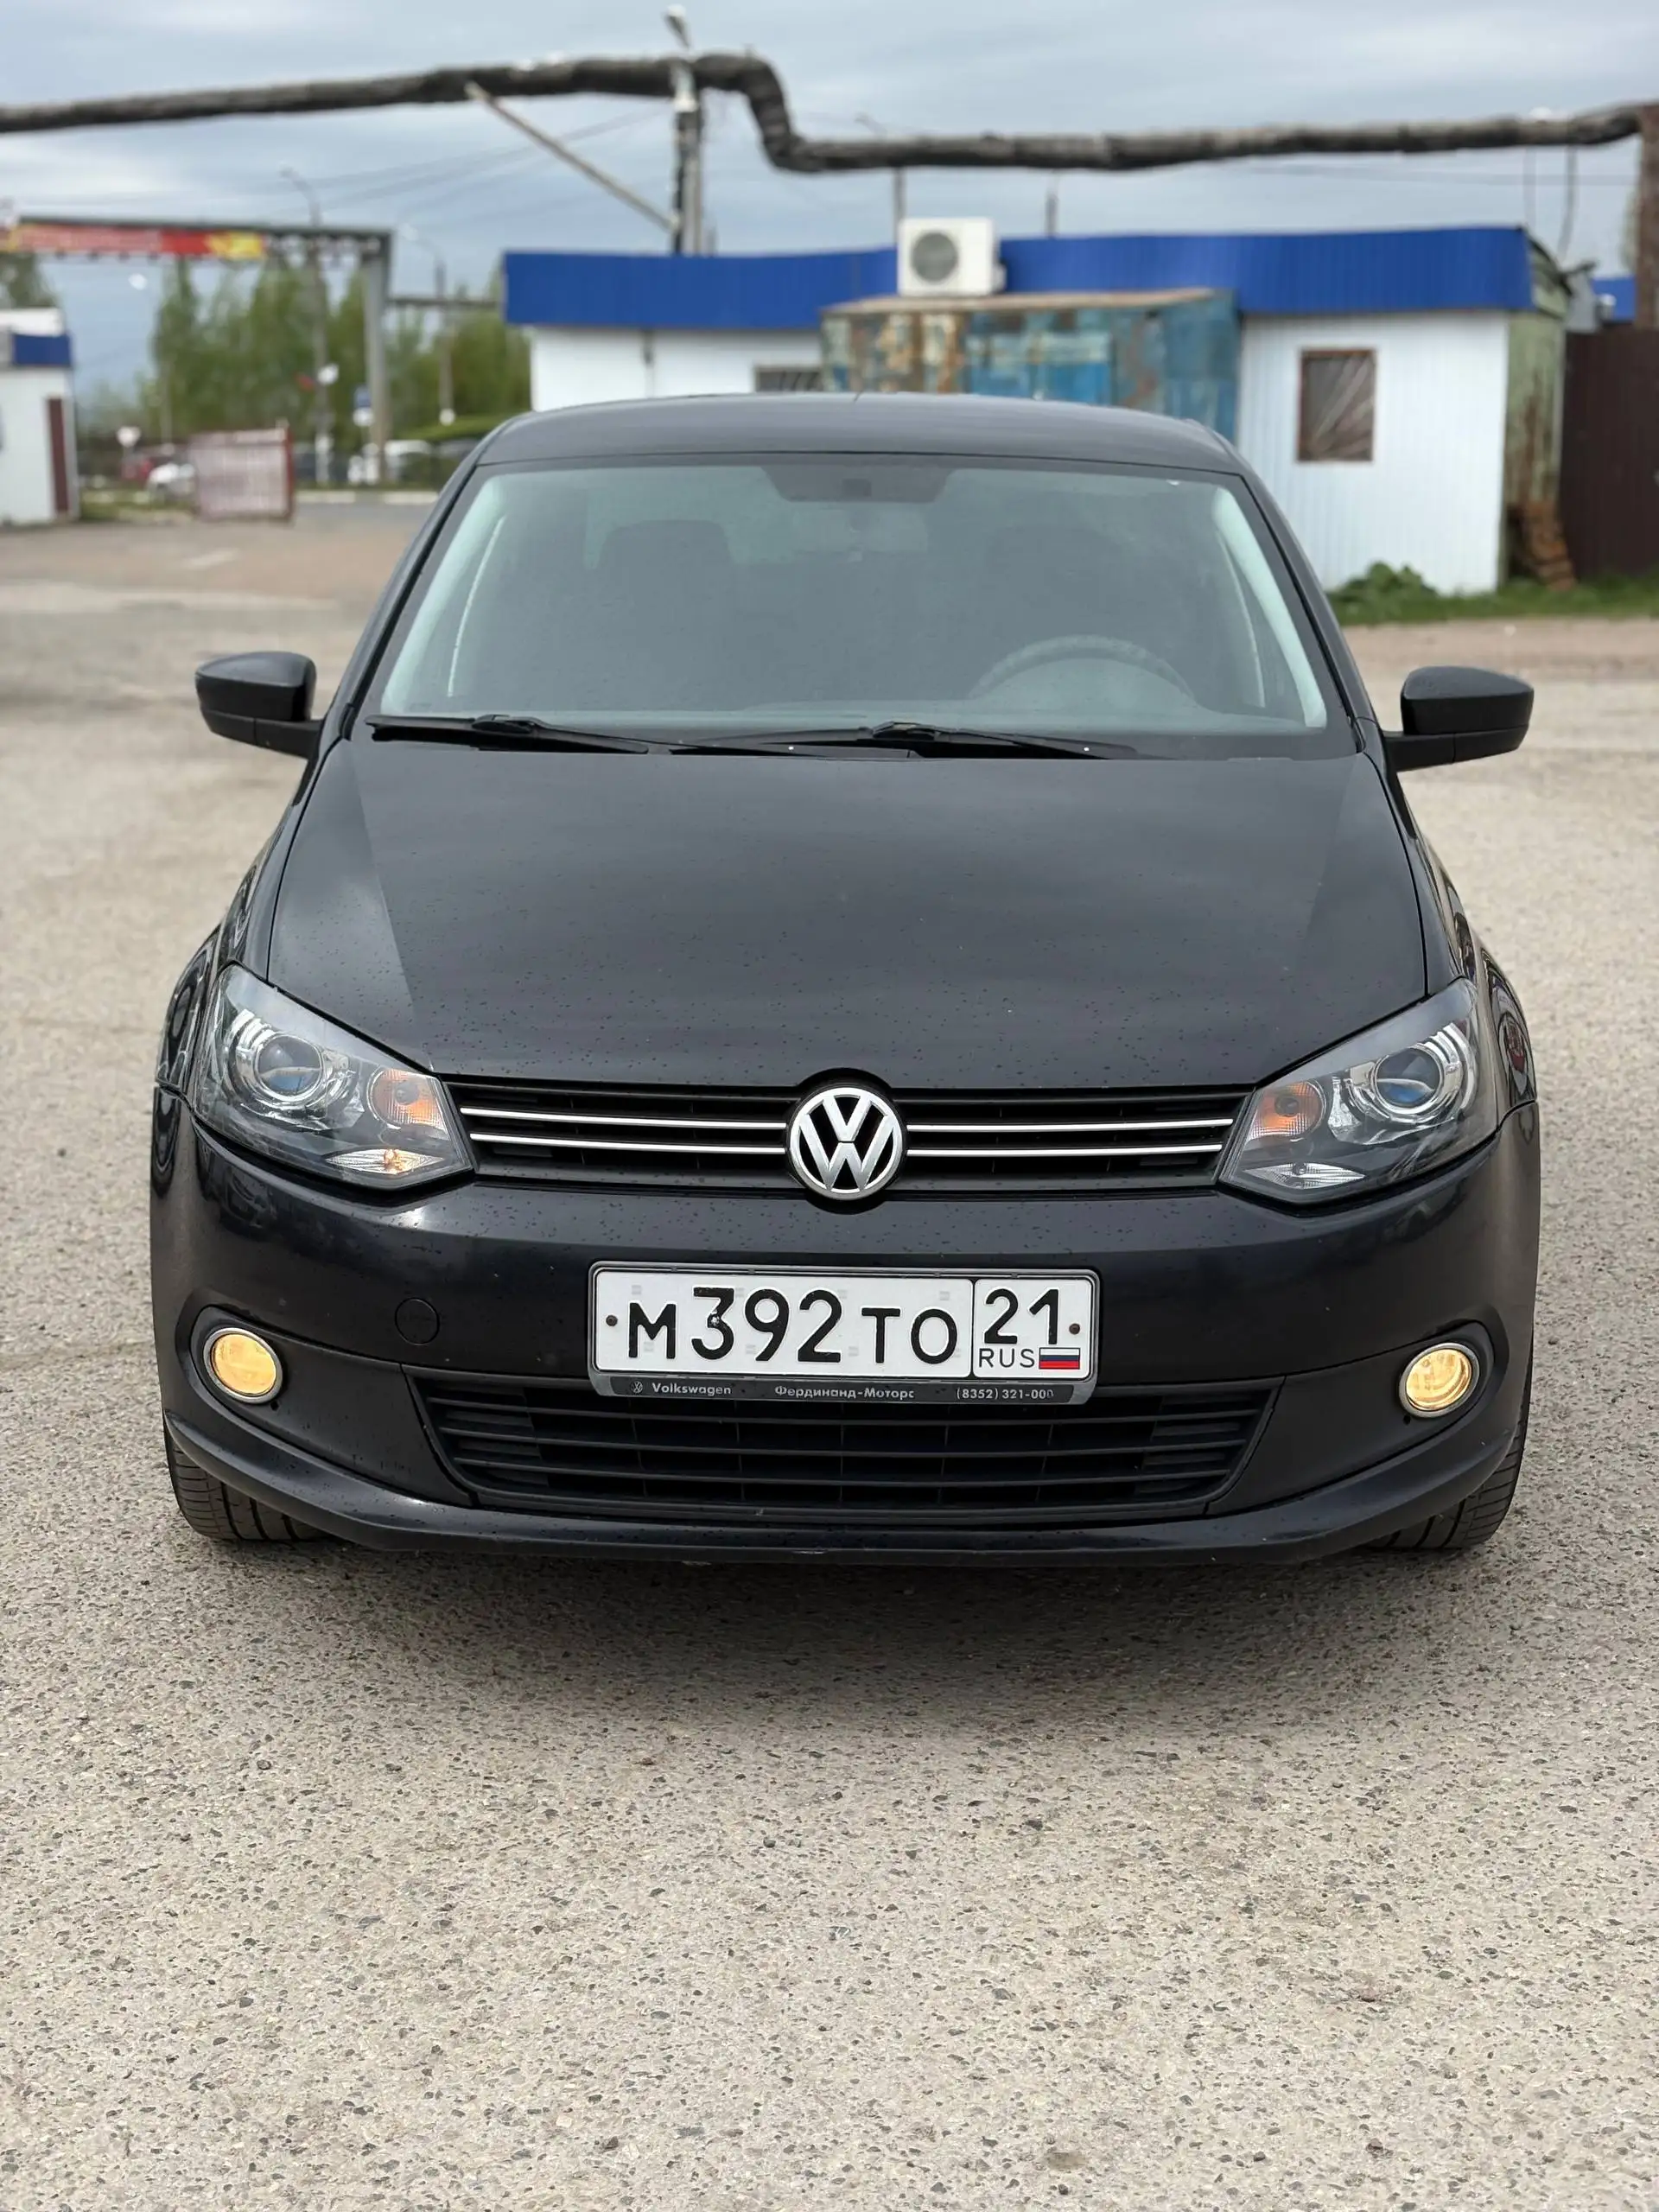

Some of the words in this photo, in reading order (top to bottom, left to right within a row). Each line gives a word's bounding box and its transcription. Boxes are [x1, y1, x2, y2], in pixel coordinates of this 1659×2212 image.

[983, 1287, 1059, 1345] 21
[978, 1347, 1035, 1369] RUS
[652, 1382, 732, 1396] Volkswagen
[774, 1384, 915, 1401] Фердинанд-Моторс
[956, 1387, 999, 1401] (8352)
